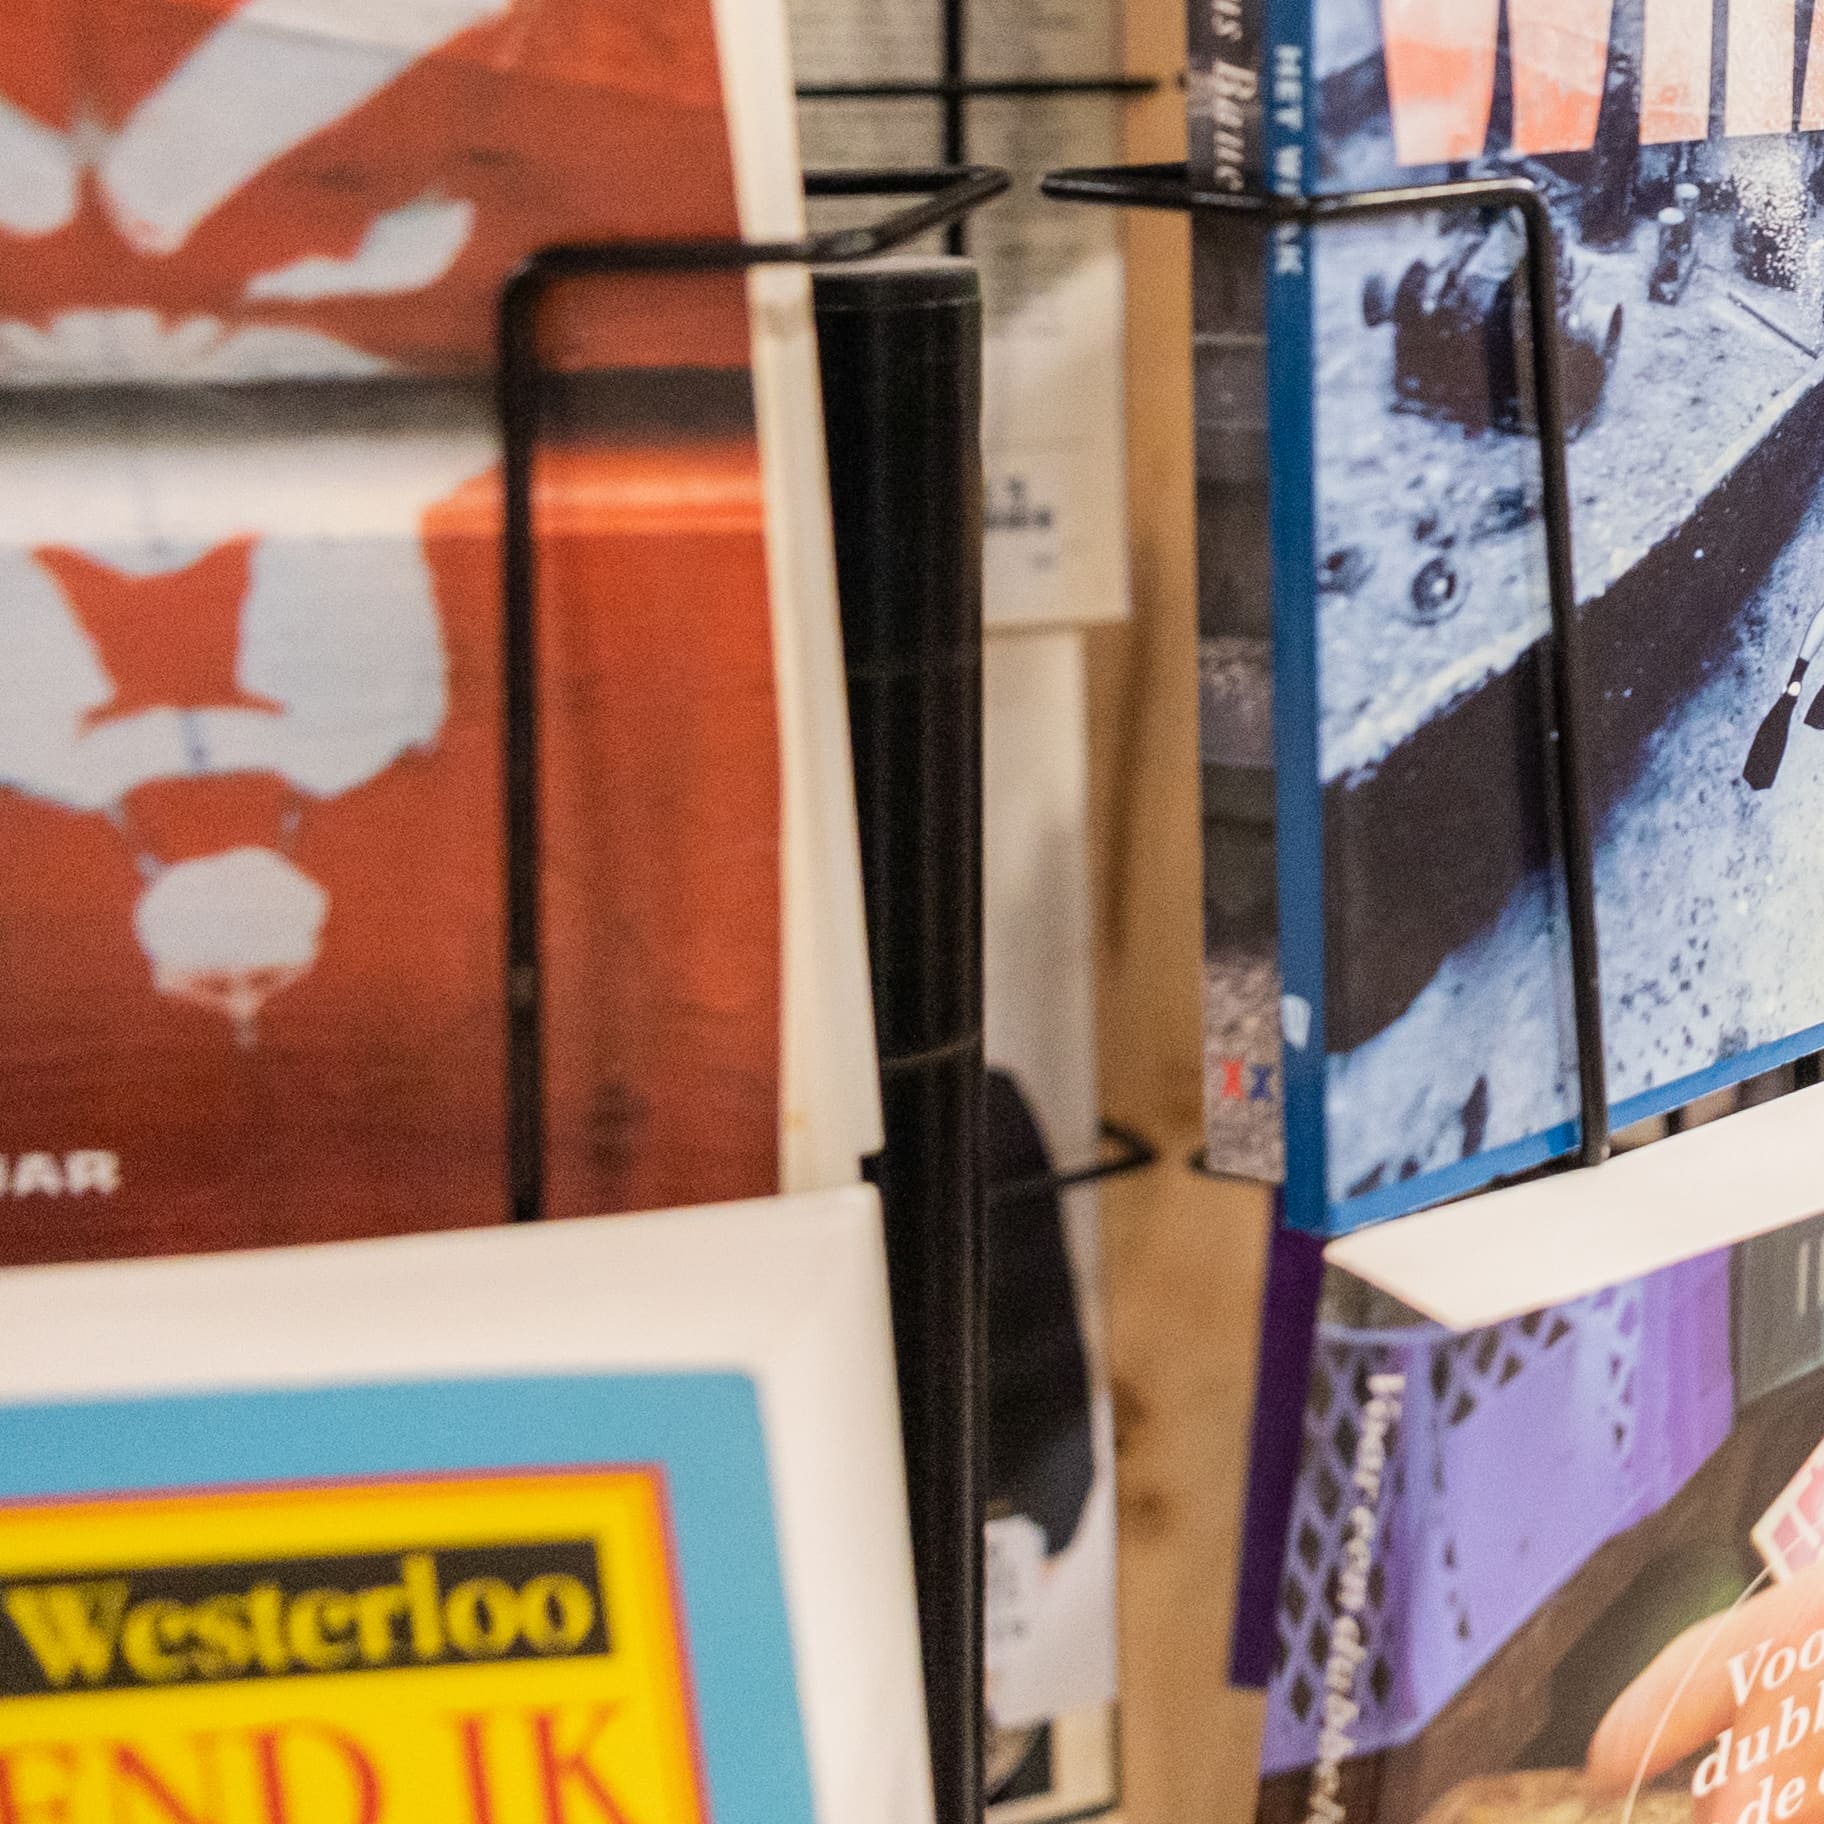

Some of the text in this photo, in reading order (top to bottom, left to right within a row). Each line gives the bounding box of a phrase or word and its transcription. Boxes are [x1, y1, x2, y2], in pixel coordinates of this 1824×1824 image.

[1213, 60, 1259, 193] Baue
[1273, 44, 1305, 133] HET
[0, 1148, 121, 1199] AR
[4, 1551, 595, 1687] Westerloo
[446, 1699, 640, 1824] IK
[1734, 1773, 1807, 1824] de
